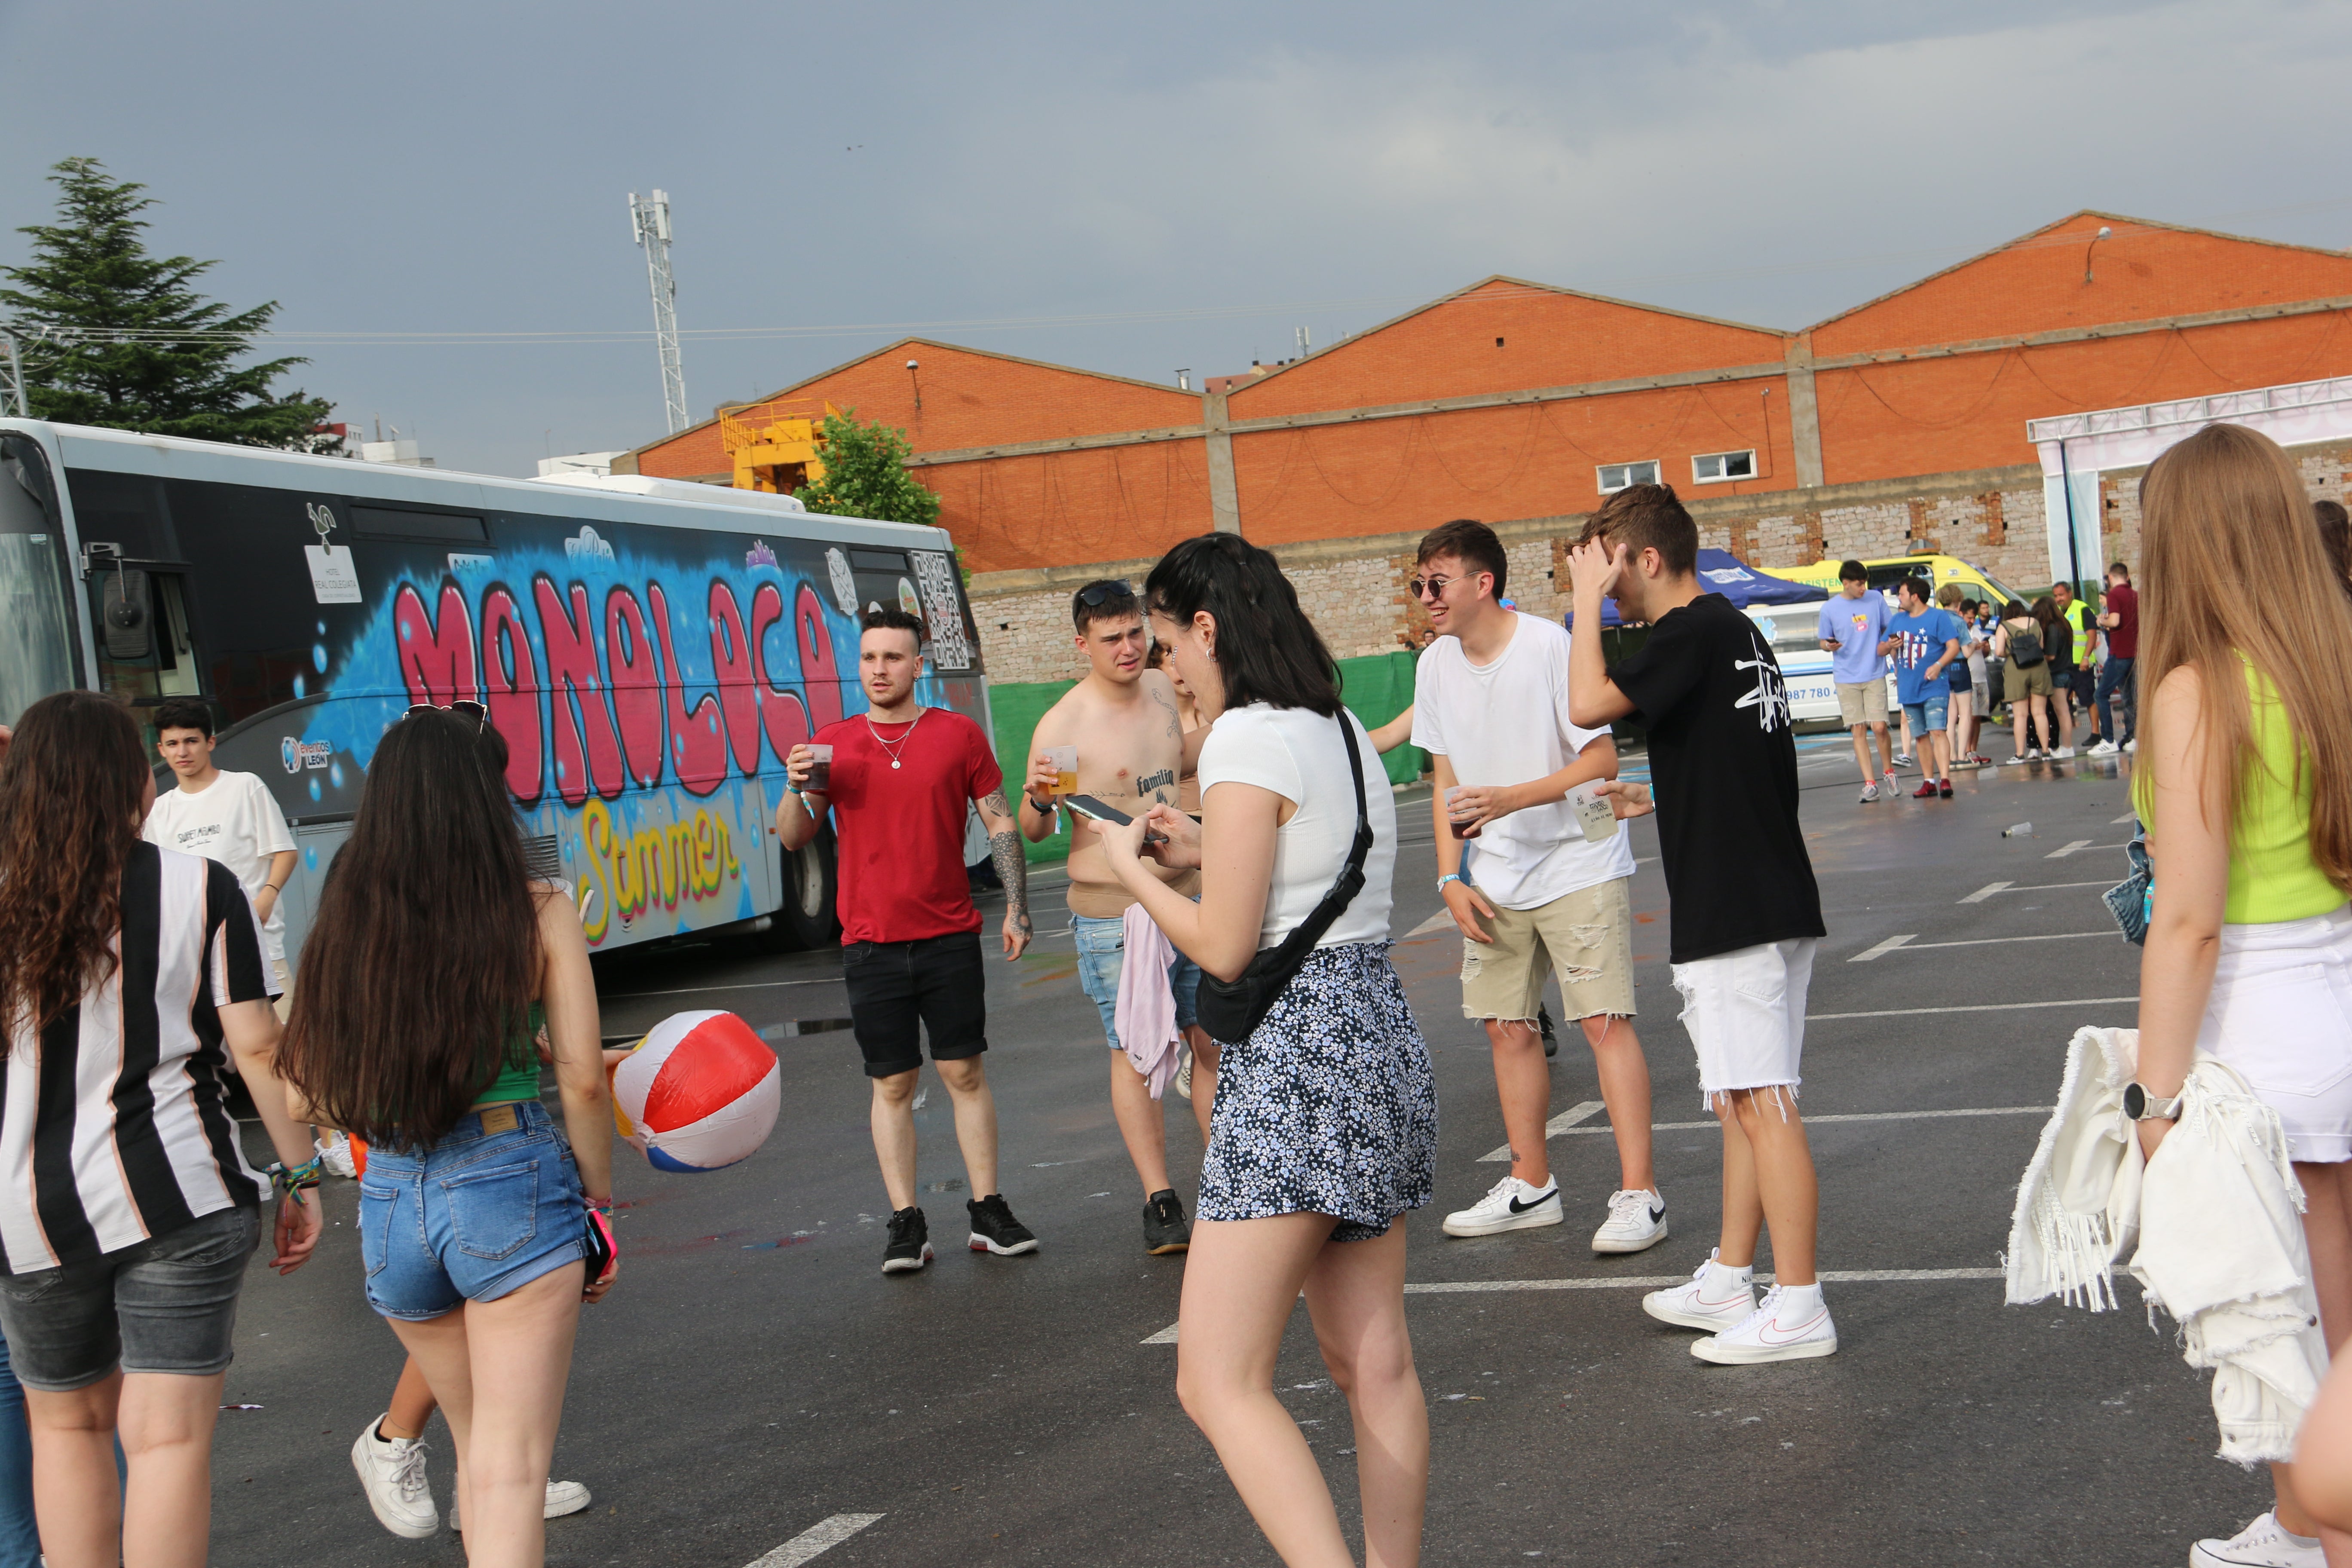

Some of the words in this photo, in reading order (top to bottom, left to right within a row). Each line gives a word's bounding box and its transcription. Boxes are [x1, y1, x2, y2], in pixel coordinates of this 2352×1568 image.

[315, 580, 328, 589] REAL
[329, 580, 358, 589] COLEGIATA
[1787, 689, 1806, 700] 987
[1809, 687, 1830, 698] 780
[300, 741, 329, 753] eventos
[308, 753, 326, 766] LEÓN
[178, 829, 197, 843] SWEET
[579, 796, 738, 946] Summer
